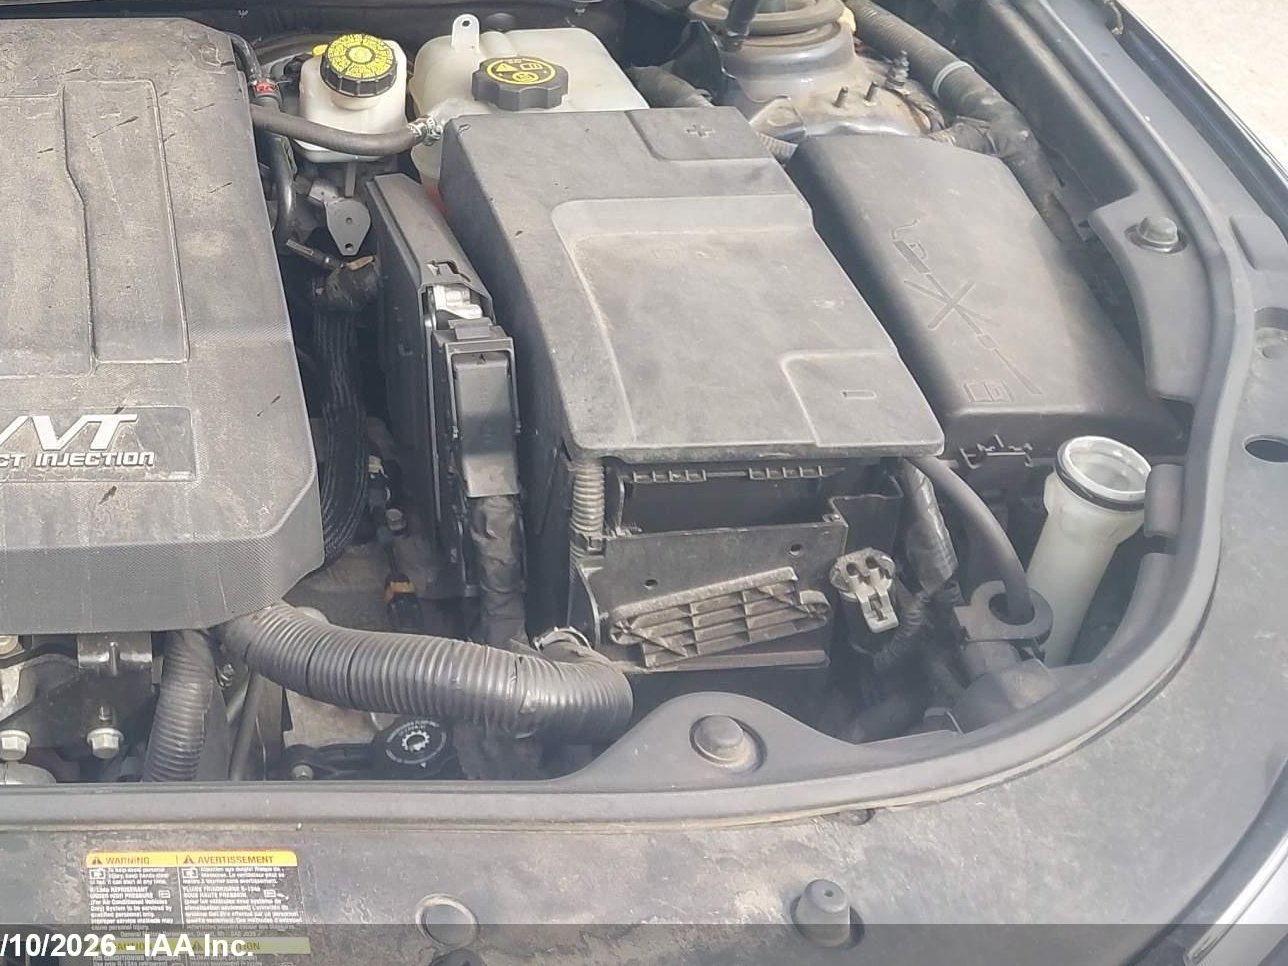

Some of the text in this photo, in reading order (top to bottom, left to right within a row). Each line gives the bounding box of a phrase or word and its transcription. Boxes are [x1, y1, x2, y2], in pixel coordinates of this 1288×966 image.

[34, 450, 156, 467] INJECTION
[105, 857, 150, 865] WARNING
[198, 855, 274, 864] AVERTISSEMENT
